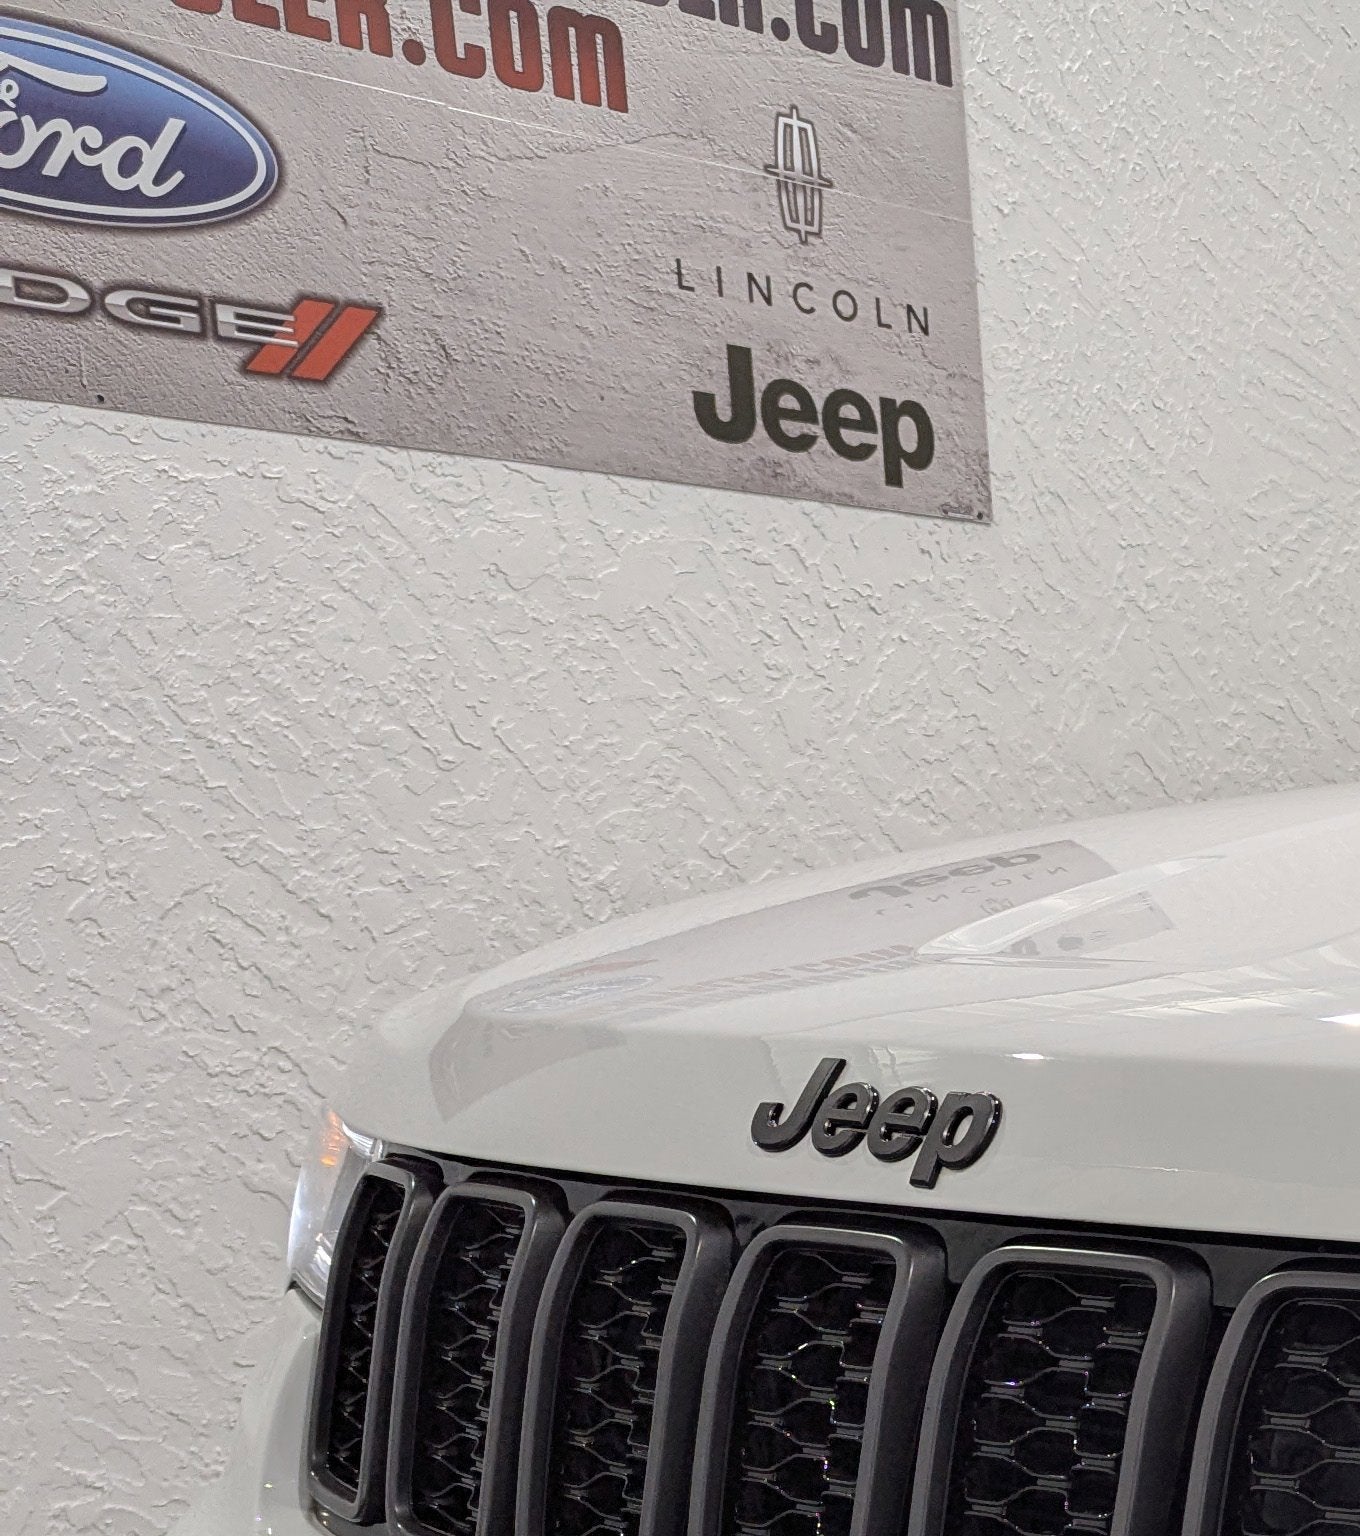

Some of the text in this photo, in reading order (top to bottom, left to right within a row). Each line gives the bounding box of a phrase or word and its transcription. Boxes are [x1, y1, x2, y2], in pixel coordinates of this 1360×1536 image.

[675, 258, 930, 336] LINCOLN
[692, 343, 935, 488] Jeep
[750, 1057, 1002, 1189] Jeep
